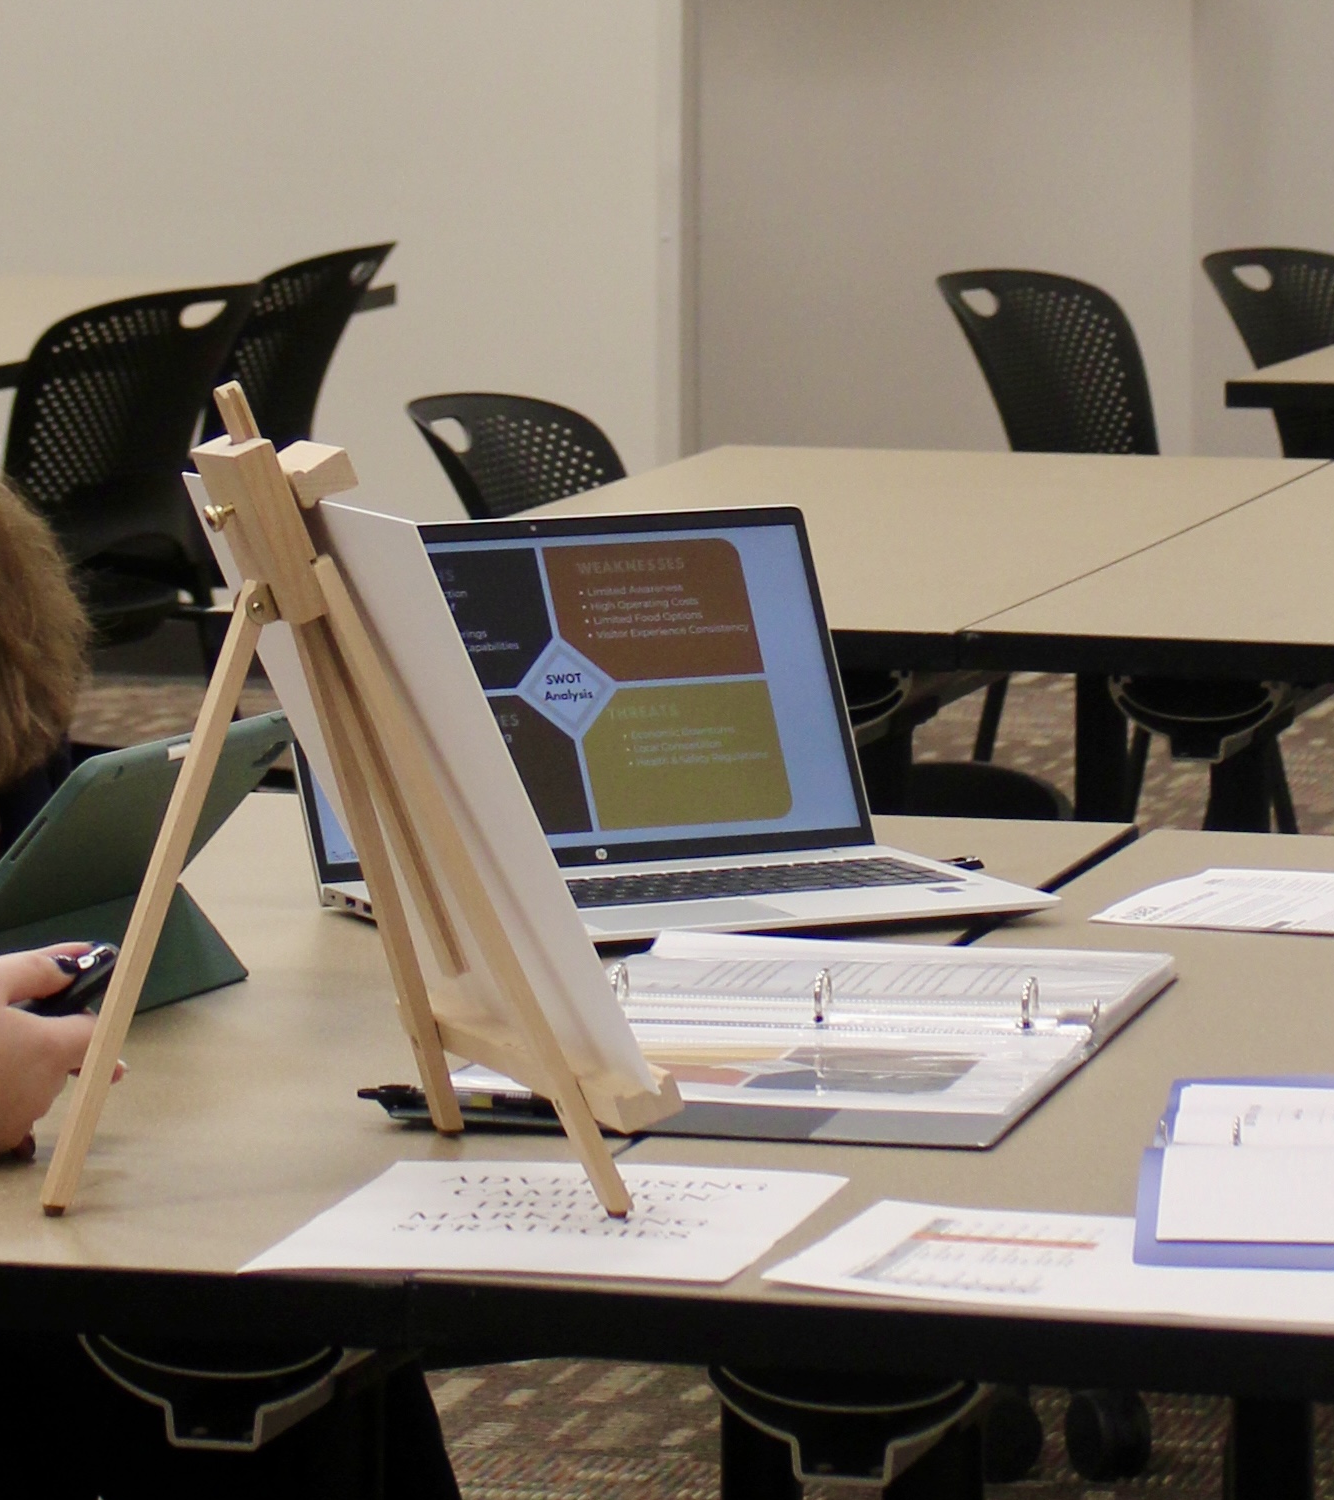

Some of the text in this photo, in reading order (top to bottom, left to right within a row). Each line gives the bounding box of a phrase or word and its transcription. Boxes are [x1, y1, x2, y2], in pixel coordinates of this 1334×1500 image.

[576, 557, 685, 575] WEAKNESSES
[635, 613, 661, 622] Food
[546, 673, 581, 685] SWOT
[545, 689, 593, 702] Analysis
